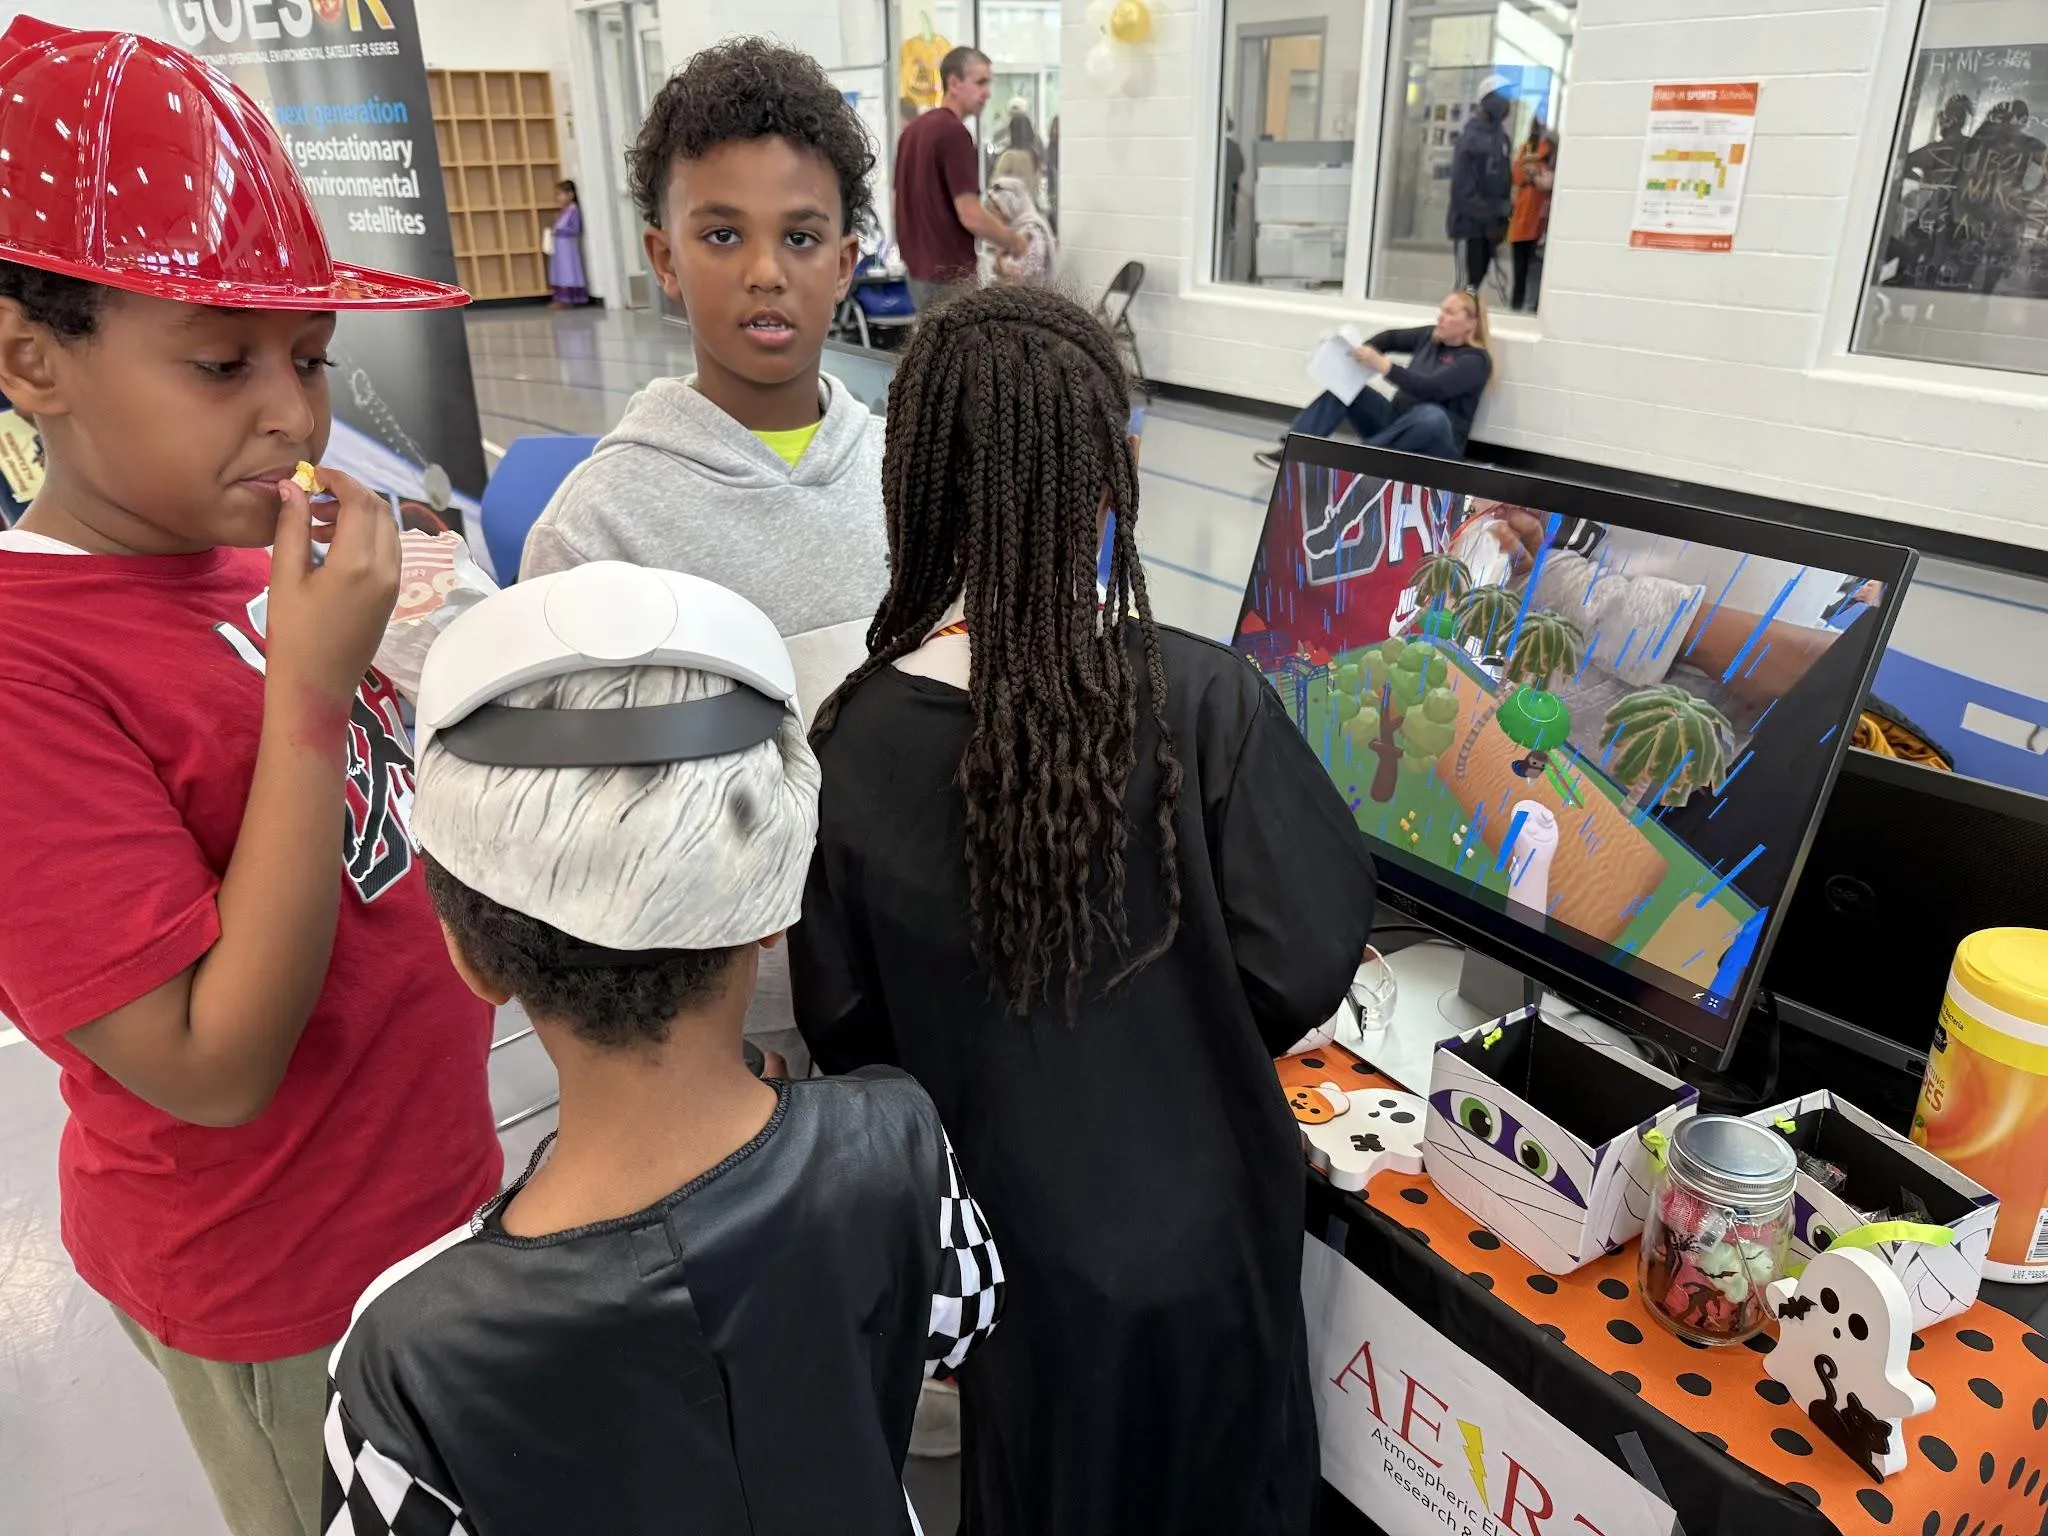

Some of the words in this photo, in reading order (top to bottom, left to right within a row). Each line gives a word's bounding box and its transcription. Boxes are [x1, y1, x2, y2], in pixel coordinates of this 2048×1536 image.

[369, 41, 400, 56] SERIES
[274, 103, 310, 126] next
[313, 95, 409, 132] generation
[295, 134, 413, 169] geostationary
[303, 169, 421, 198] nvironmental
[347, 205, 427, 236] satellites
[1371, 1427, 1478, 1524] Atmospheric
[1383, 1459, 1457, 1532] Research
